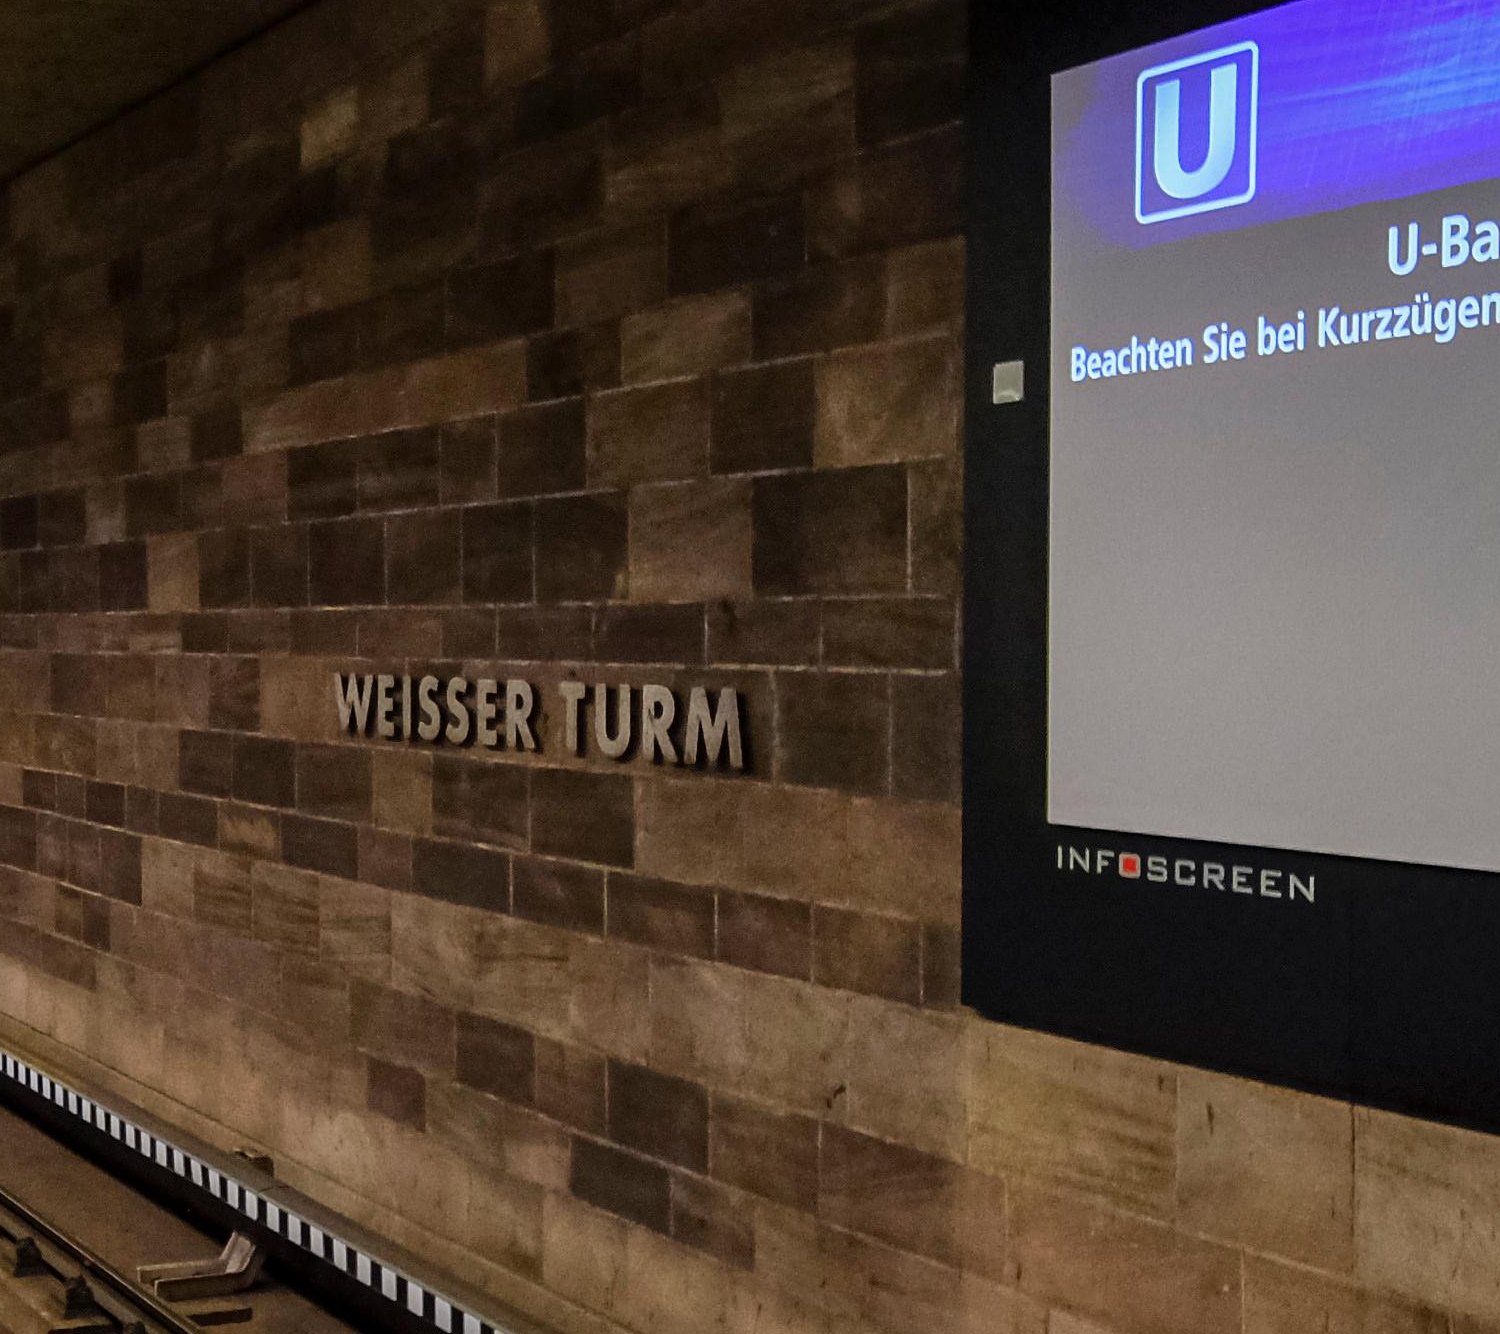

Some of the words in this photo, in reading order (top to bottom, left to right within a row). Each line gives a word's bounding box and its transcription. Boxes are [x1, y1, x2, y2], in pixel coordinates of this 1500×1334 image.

[1154, 63, 1238, 199] U
[1070, 338, 1193, 383] Beachten
[1202, 320, 1248, 365] Sie
[1256, 310, 1306, 355] bei
[334, 672, 536, 751] WEISSER
[559, 680, 744, 769] TURM
[1057, 844, 1316, 904] INFOSCREEN
